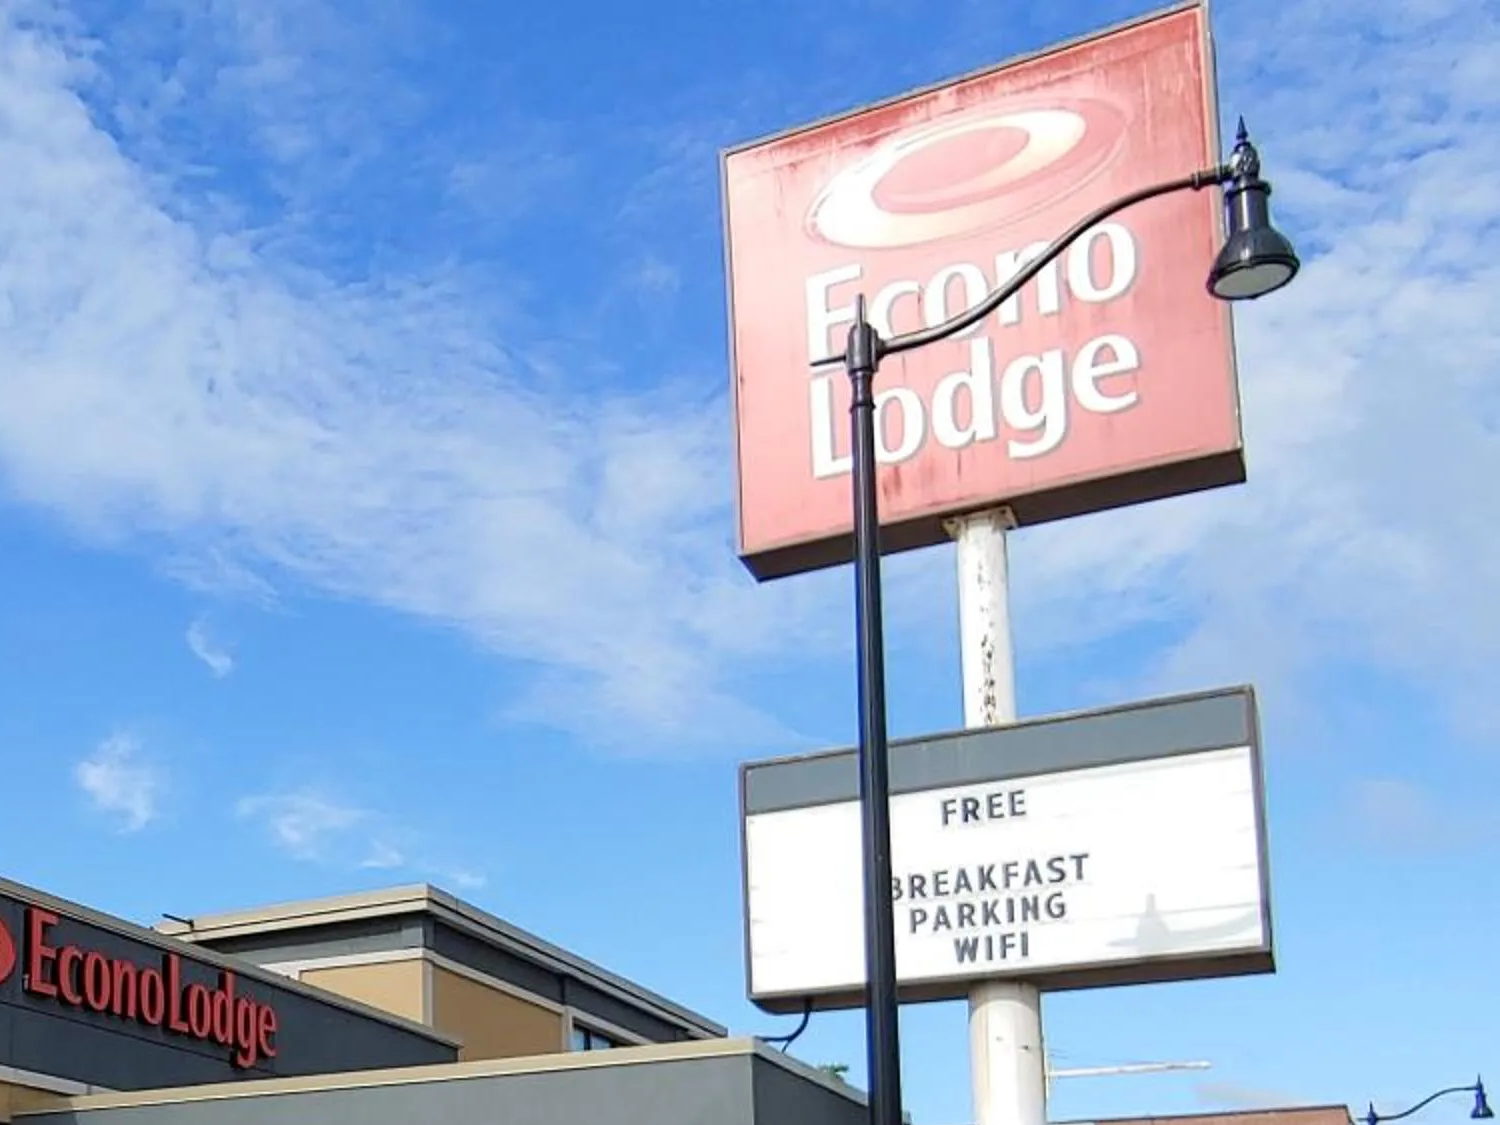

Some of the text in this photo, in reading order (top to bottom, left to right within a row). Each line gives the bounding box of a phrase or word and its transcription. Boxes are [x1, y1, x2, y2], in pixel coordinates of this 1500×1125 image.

[805, 222, 1138, 373] Econo
[810, 333, 1140, 480] Lodge
[940, 790, 1027, 826] FREE
[891, 853, 1090, 901] BREAKFAST
[909, 892, 1067, 934] PARKING
[953, 931, 1030, 964] WIFI
[28, 905, 277, 1068] EconoLodge
